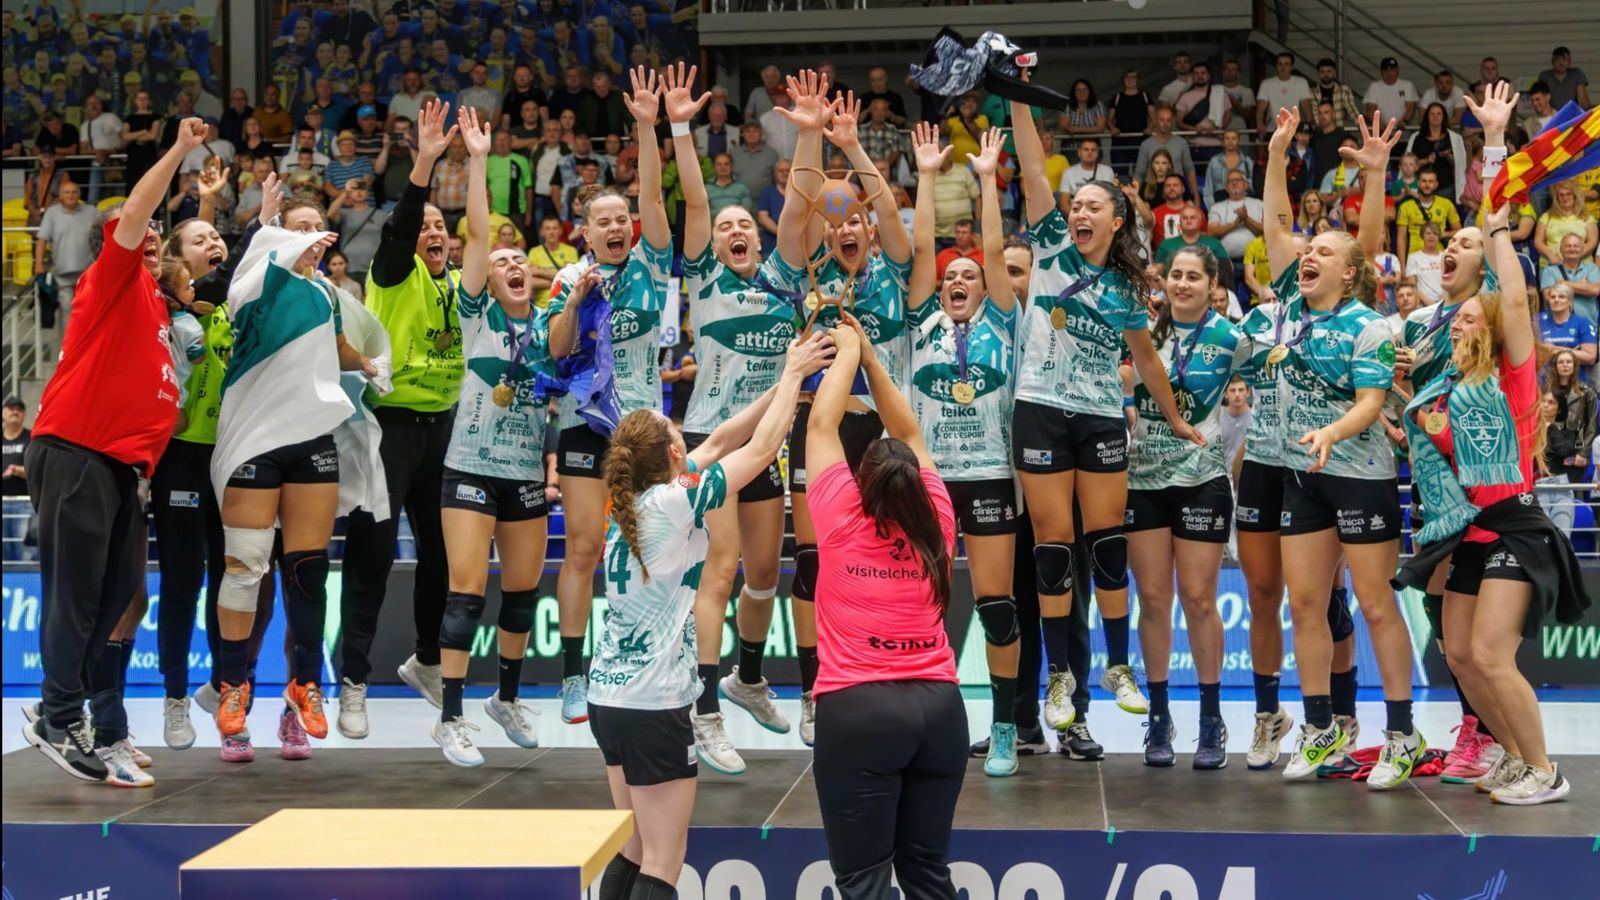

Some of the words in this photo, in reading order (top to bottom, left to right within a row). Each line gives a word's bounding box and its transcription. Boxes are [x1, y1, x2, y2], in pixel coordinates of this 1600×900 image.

[746, 360, 776, 371] teika
[1260, 391, 1276, 406] tei
[941, 405, 977, 418] teika
[940, 425, 981, 433] COMUNITAT
[943, 432, 952, 440] DE
[1097, 447, 1125, 459] clinica
[1102, 456, 1124, 465] tesla
[457, 492, 479, 501] suma
[973, 507, 1001, 516] clinica
[1182, 514, 1212, 524] clinica
[1185, 522, 1208, 531] tesla
[60, 886, 110, 900] HE
